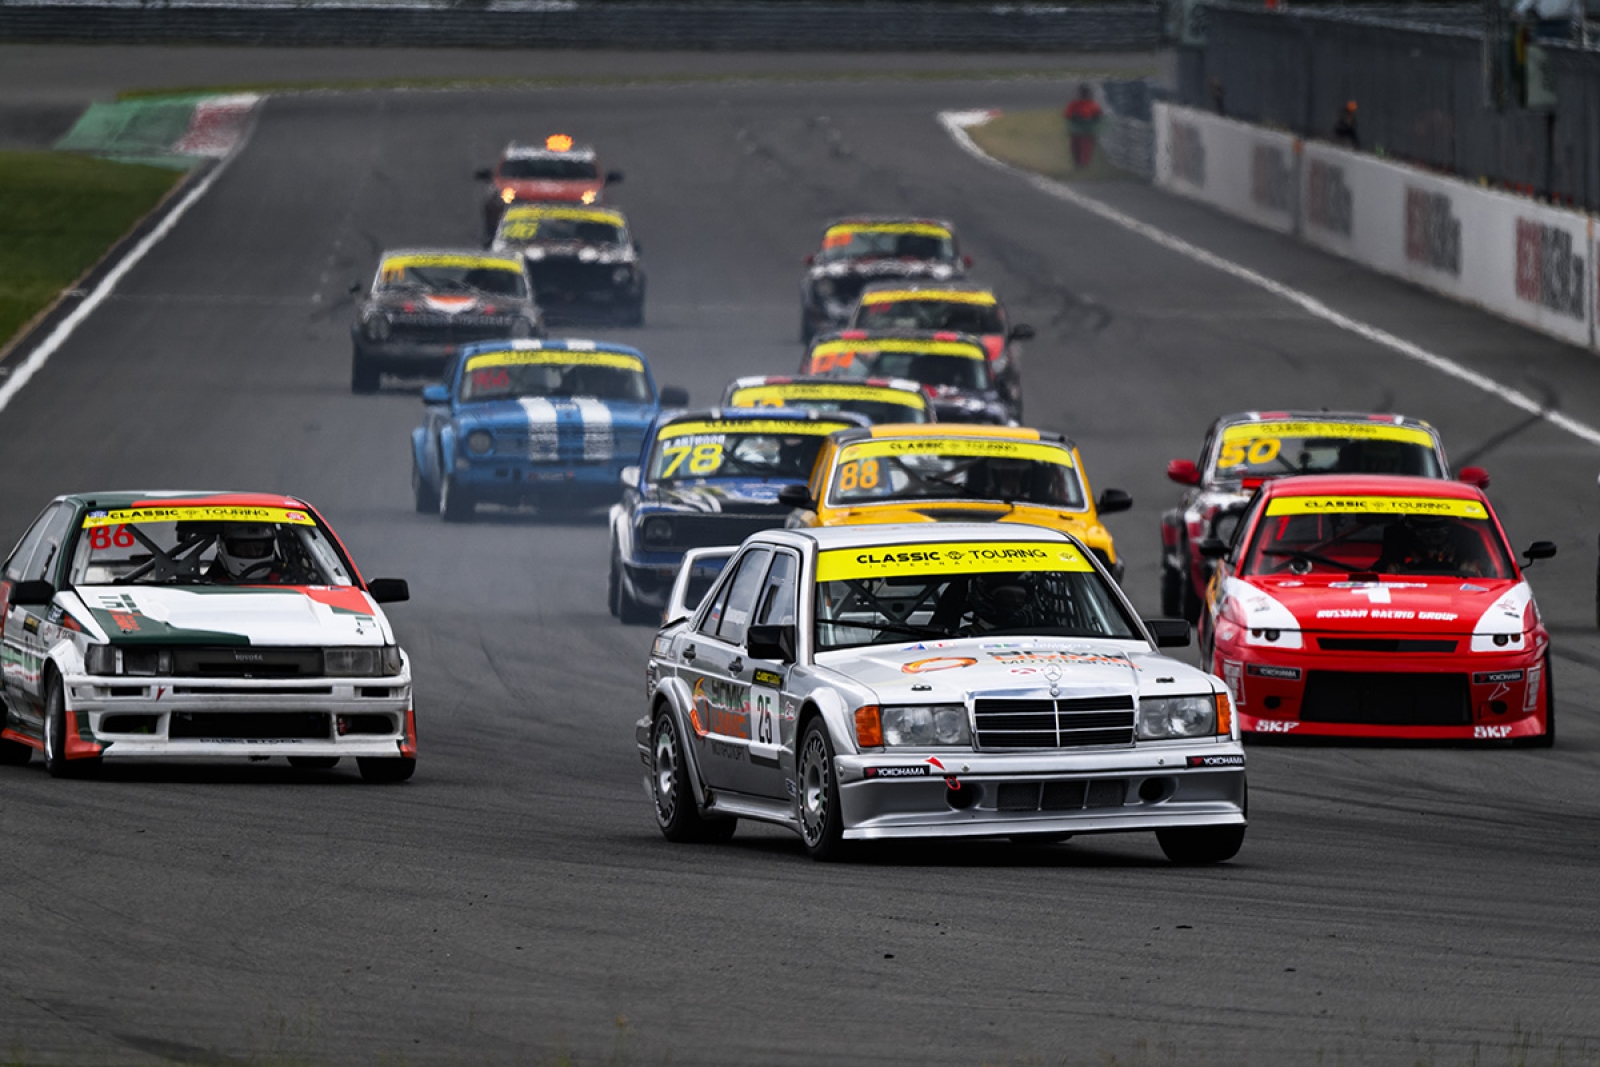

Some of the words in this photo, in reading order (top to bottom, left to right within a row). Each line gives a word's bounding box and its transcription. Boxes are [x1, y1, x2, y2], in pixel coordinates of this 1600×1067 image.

[889, 442, 944, 450] CLASSIC
[1217, 438, 1281, 468] 50
[662, 443, 724, 479] 78
[840, 460, 879, 490] 88
[1304, 500, 1367, 509] CLASSIC
[1390, 501, 1451, 510] TOURING
[110, 509, 179, 520] CLASSIC
[204, 507, 269, 517] TOURING
[89, 523, 135, 550] 86
[856, 551, 941, 564] CLASSIC
[968, 549, 1048, 560] TOURING
[1418, 611, 1458, 622] GROUP
[757, 694, 773, 744] 25
[1255, 719, 1300, 733] SKF
[1474, 725, 1513, 738] SKF
[877, 767, 926, 776] YOKOHAMA
